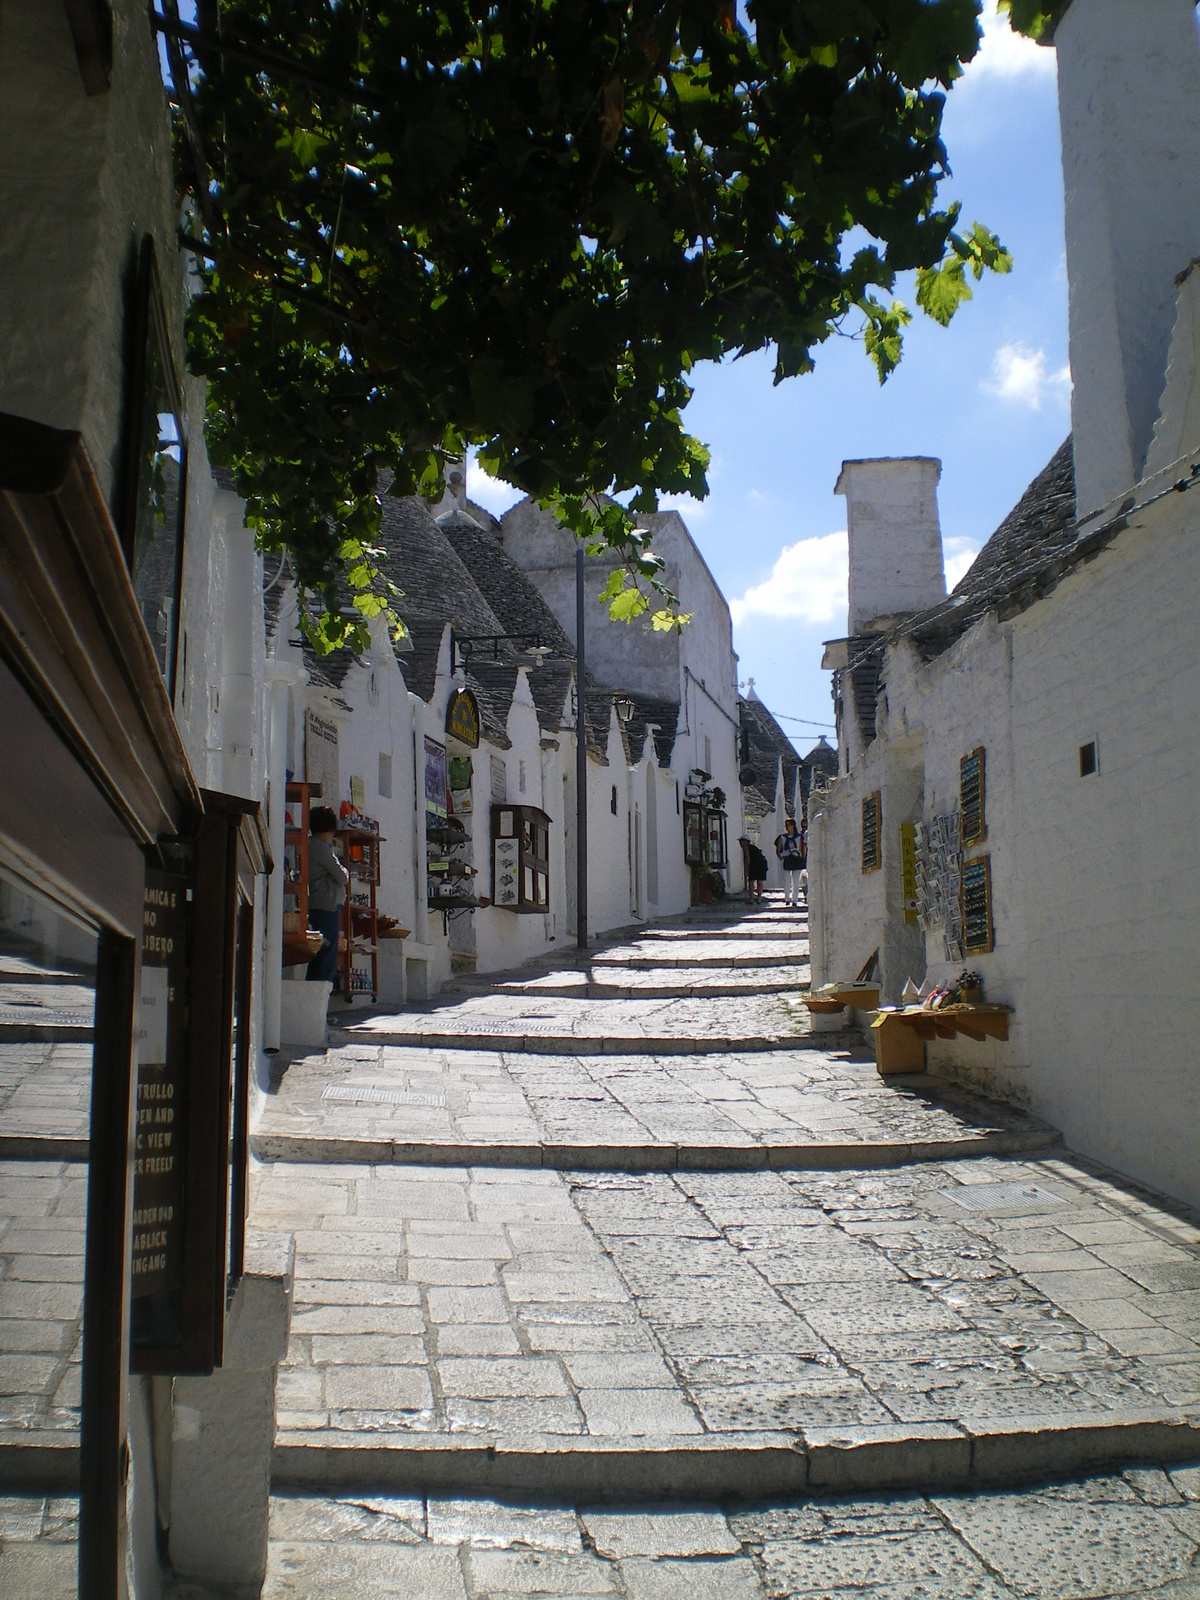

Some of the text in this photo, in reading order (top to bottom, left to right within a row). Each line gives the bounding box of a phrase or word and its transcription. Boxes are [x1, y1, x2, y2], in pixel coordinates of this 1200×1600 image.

[142, 934, 173, 953] IBERO
[137, 1083, 174, 1100] TRULLO
[154, 1107, 174, 1124] AND
[147, 1132, 172, 1148] VIEW
[145, 1156, 174, 1173] FREELY
